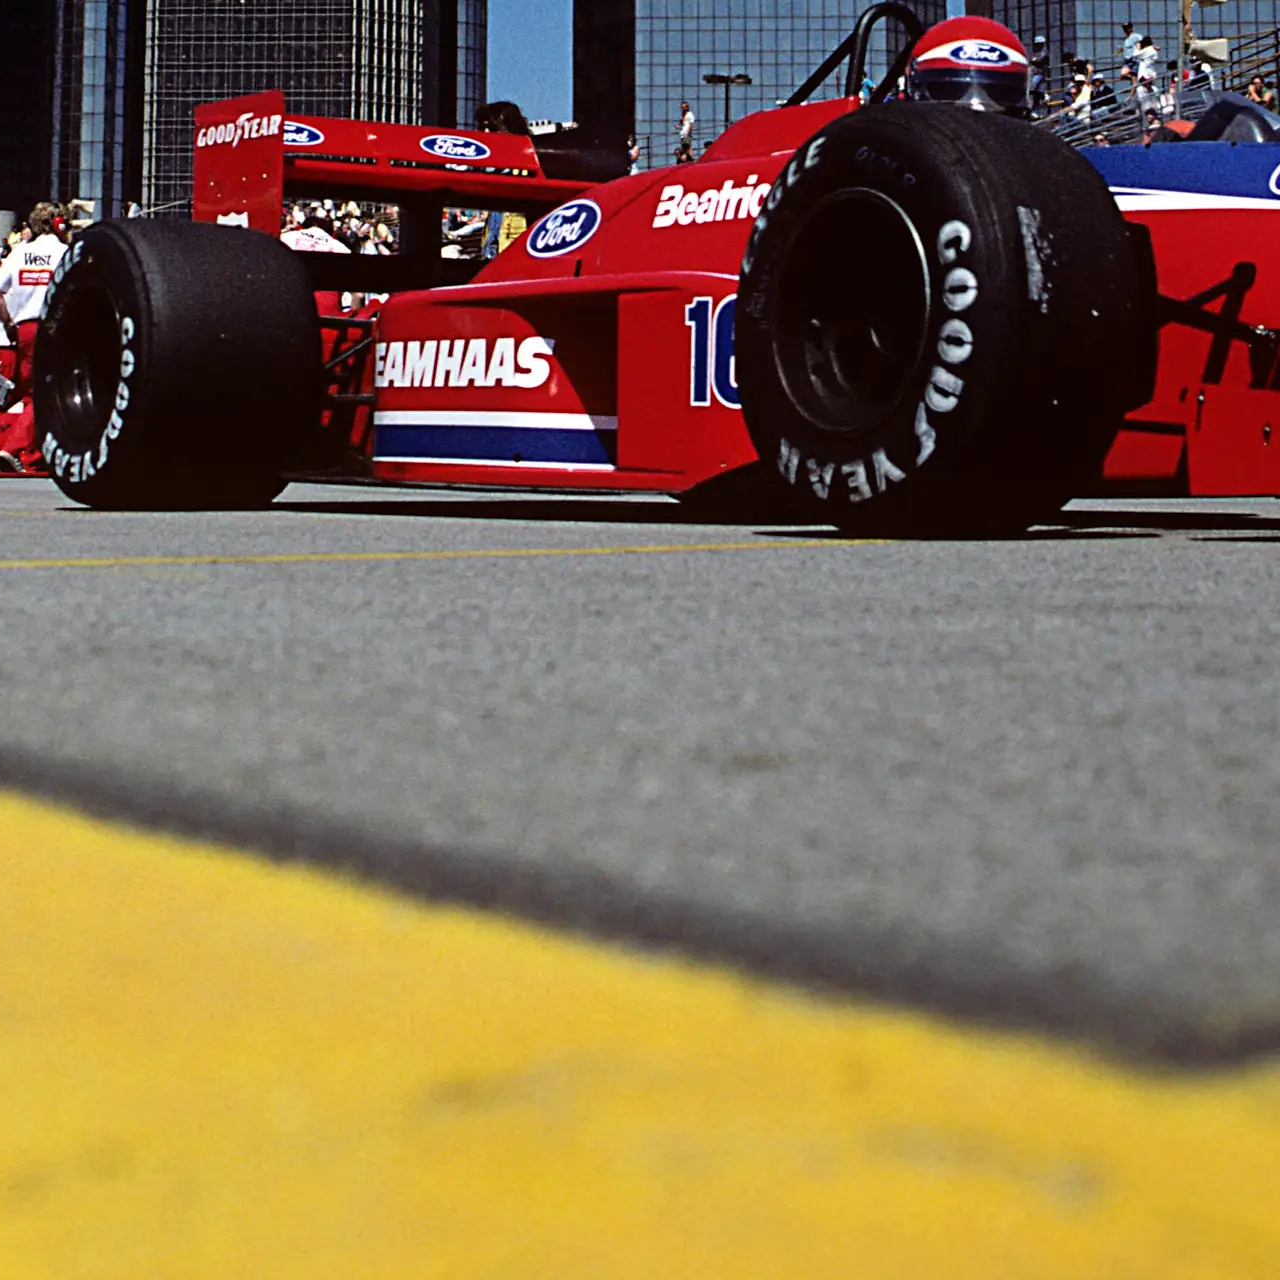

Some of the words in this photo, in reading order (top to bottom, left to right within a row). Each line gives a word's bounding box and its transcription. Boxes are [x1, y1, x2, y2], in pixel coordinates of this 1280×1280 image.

[958, 42, 1001, 61] Ford
[196, 112, 282, 148] GOODYEAR
[433, 136, 478, 158] Ford
[651, 173, 772, 228] Beatric
[535, 206, 587, 250] Ford
[24, 252, 52, 266] West
[374, 336, 554, 389] EAMHAAS
